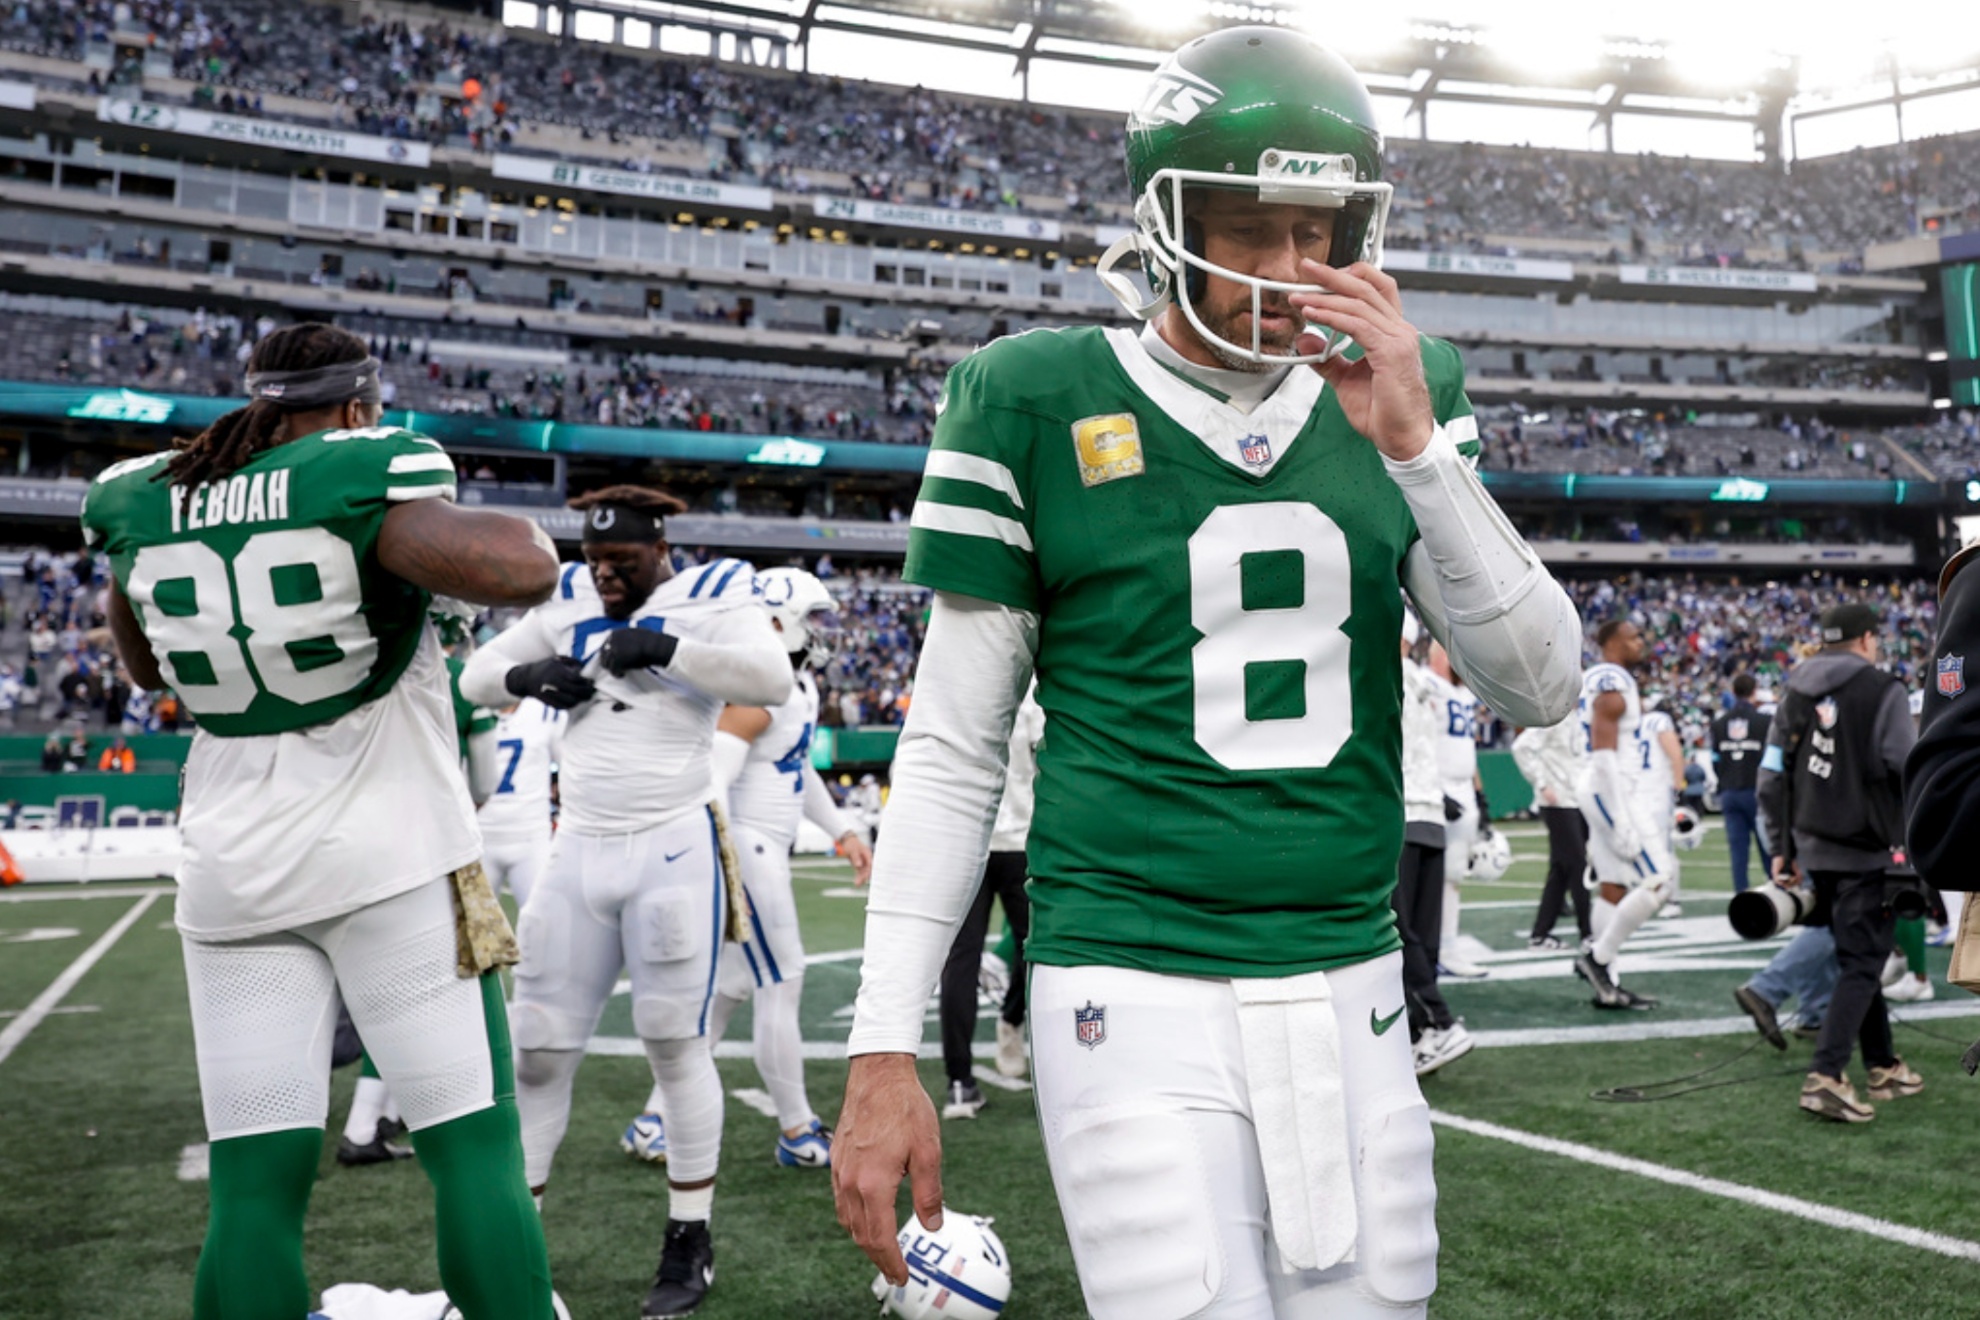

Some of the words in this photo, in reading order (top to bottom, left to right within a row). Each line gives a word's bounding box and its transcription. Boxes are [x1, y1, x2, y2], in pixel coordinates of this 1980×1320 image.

[128, 104, 160, 122] 12
[209, 118, 246, 137] JOE
[251, 126, 346, 151] NAMATH
[553, 164, 580, 184] 81
[1281, 159, 1328, 175] NY
[825, 200, 856, 218] 24
[66, 388, 175, 424] JETS
[170, 468, 290, 533] YEBOAH
[127, 527, 378, 714] 88
[1188, 502, 1353, 770] 8
